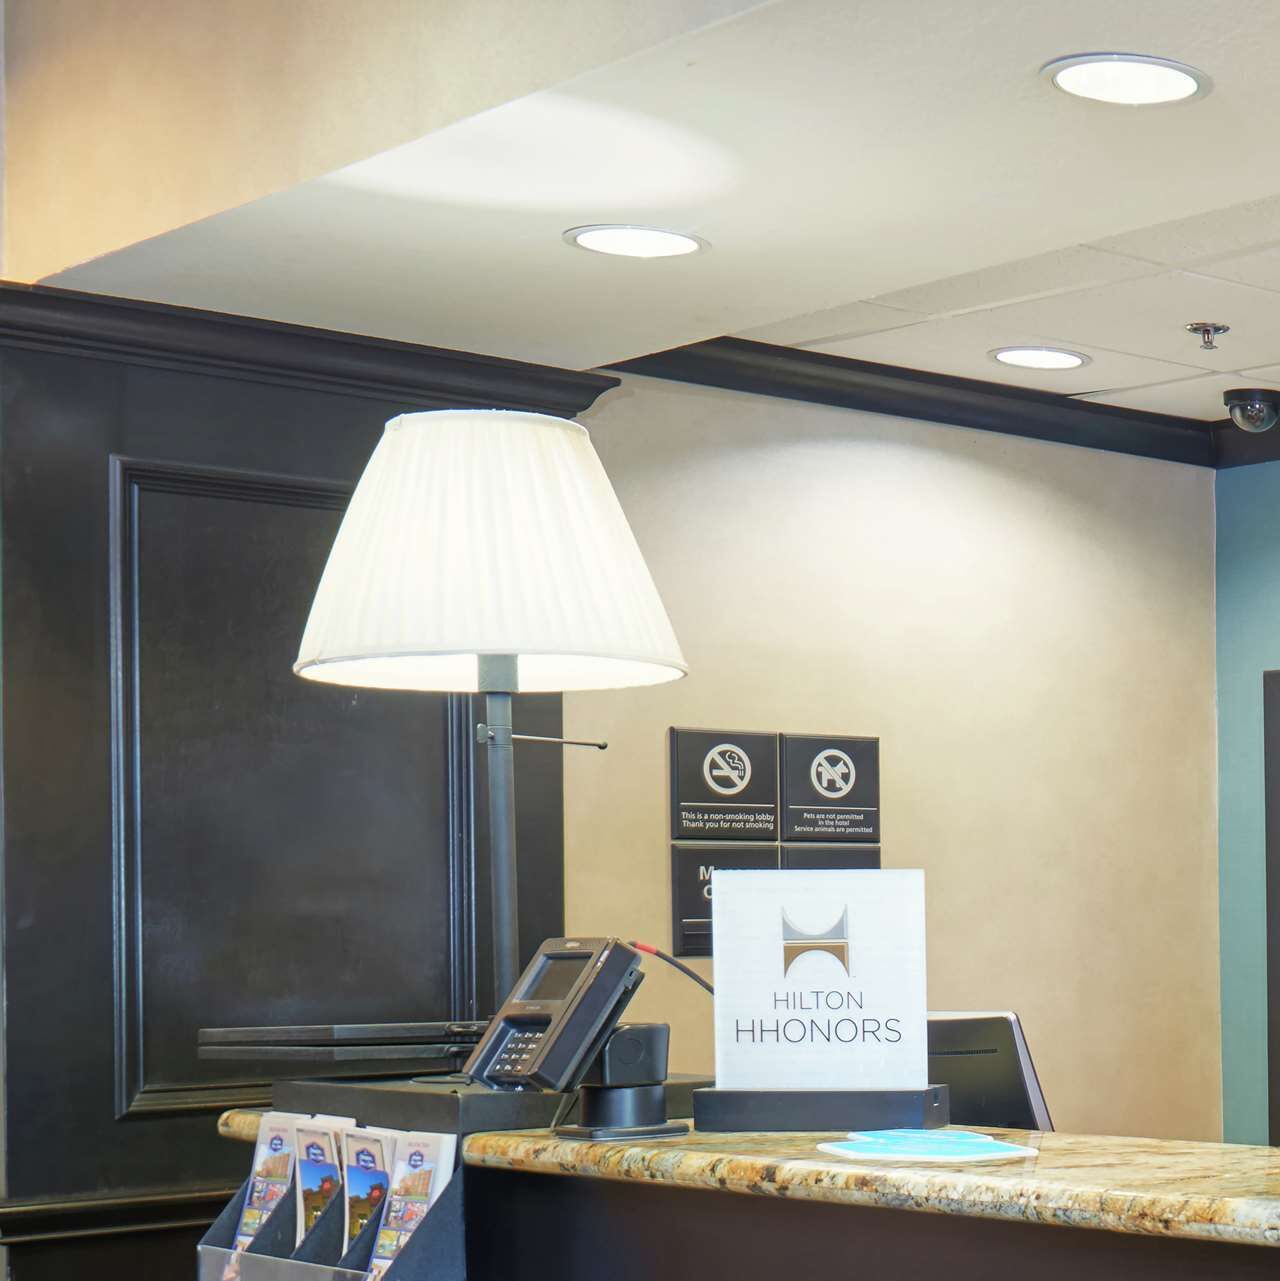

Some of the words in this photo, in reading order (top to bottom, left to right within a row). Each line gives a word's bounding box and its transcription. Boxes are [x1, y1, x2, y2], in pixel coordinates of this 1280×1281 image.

[682, 820, 704, 828] Thank
[705, 821, 719, 829] you
[720, 820, 730, 828] for
[745, 821, 774, 830] smoking
[709, 813, 754, 821] non-smoking
[755, 813, 775, 822] lobby
[773, 990, 863, 1010] HILTON
[735, 1018, 902, 1043] HHONORS
